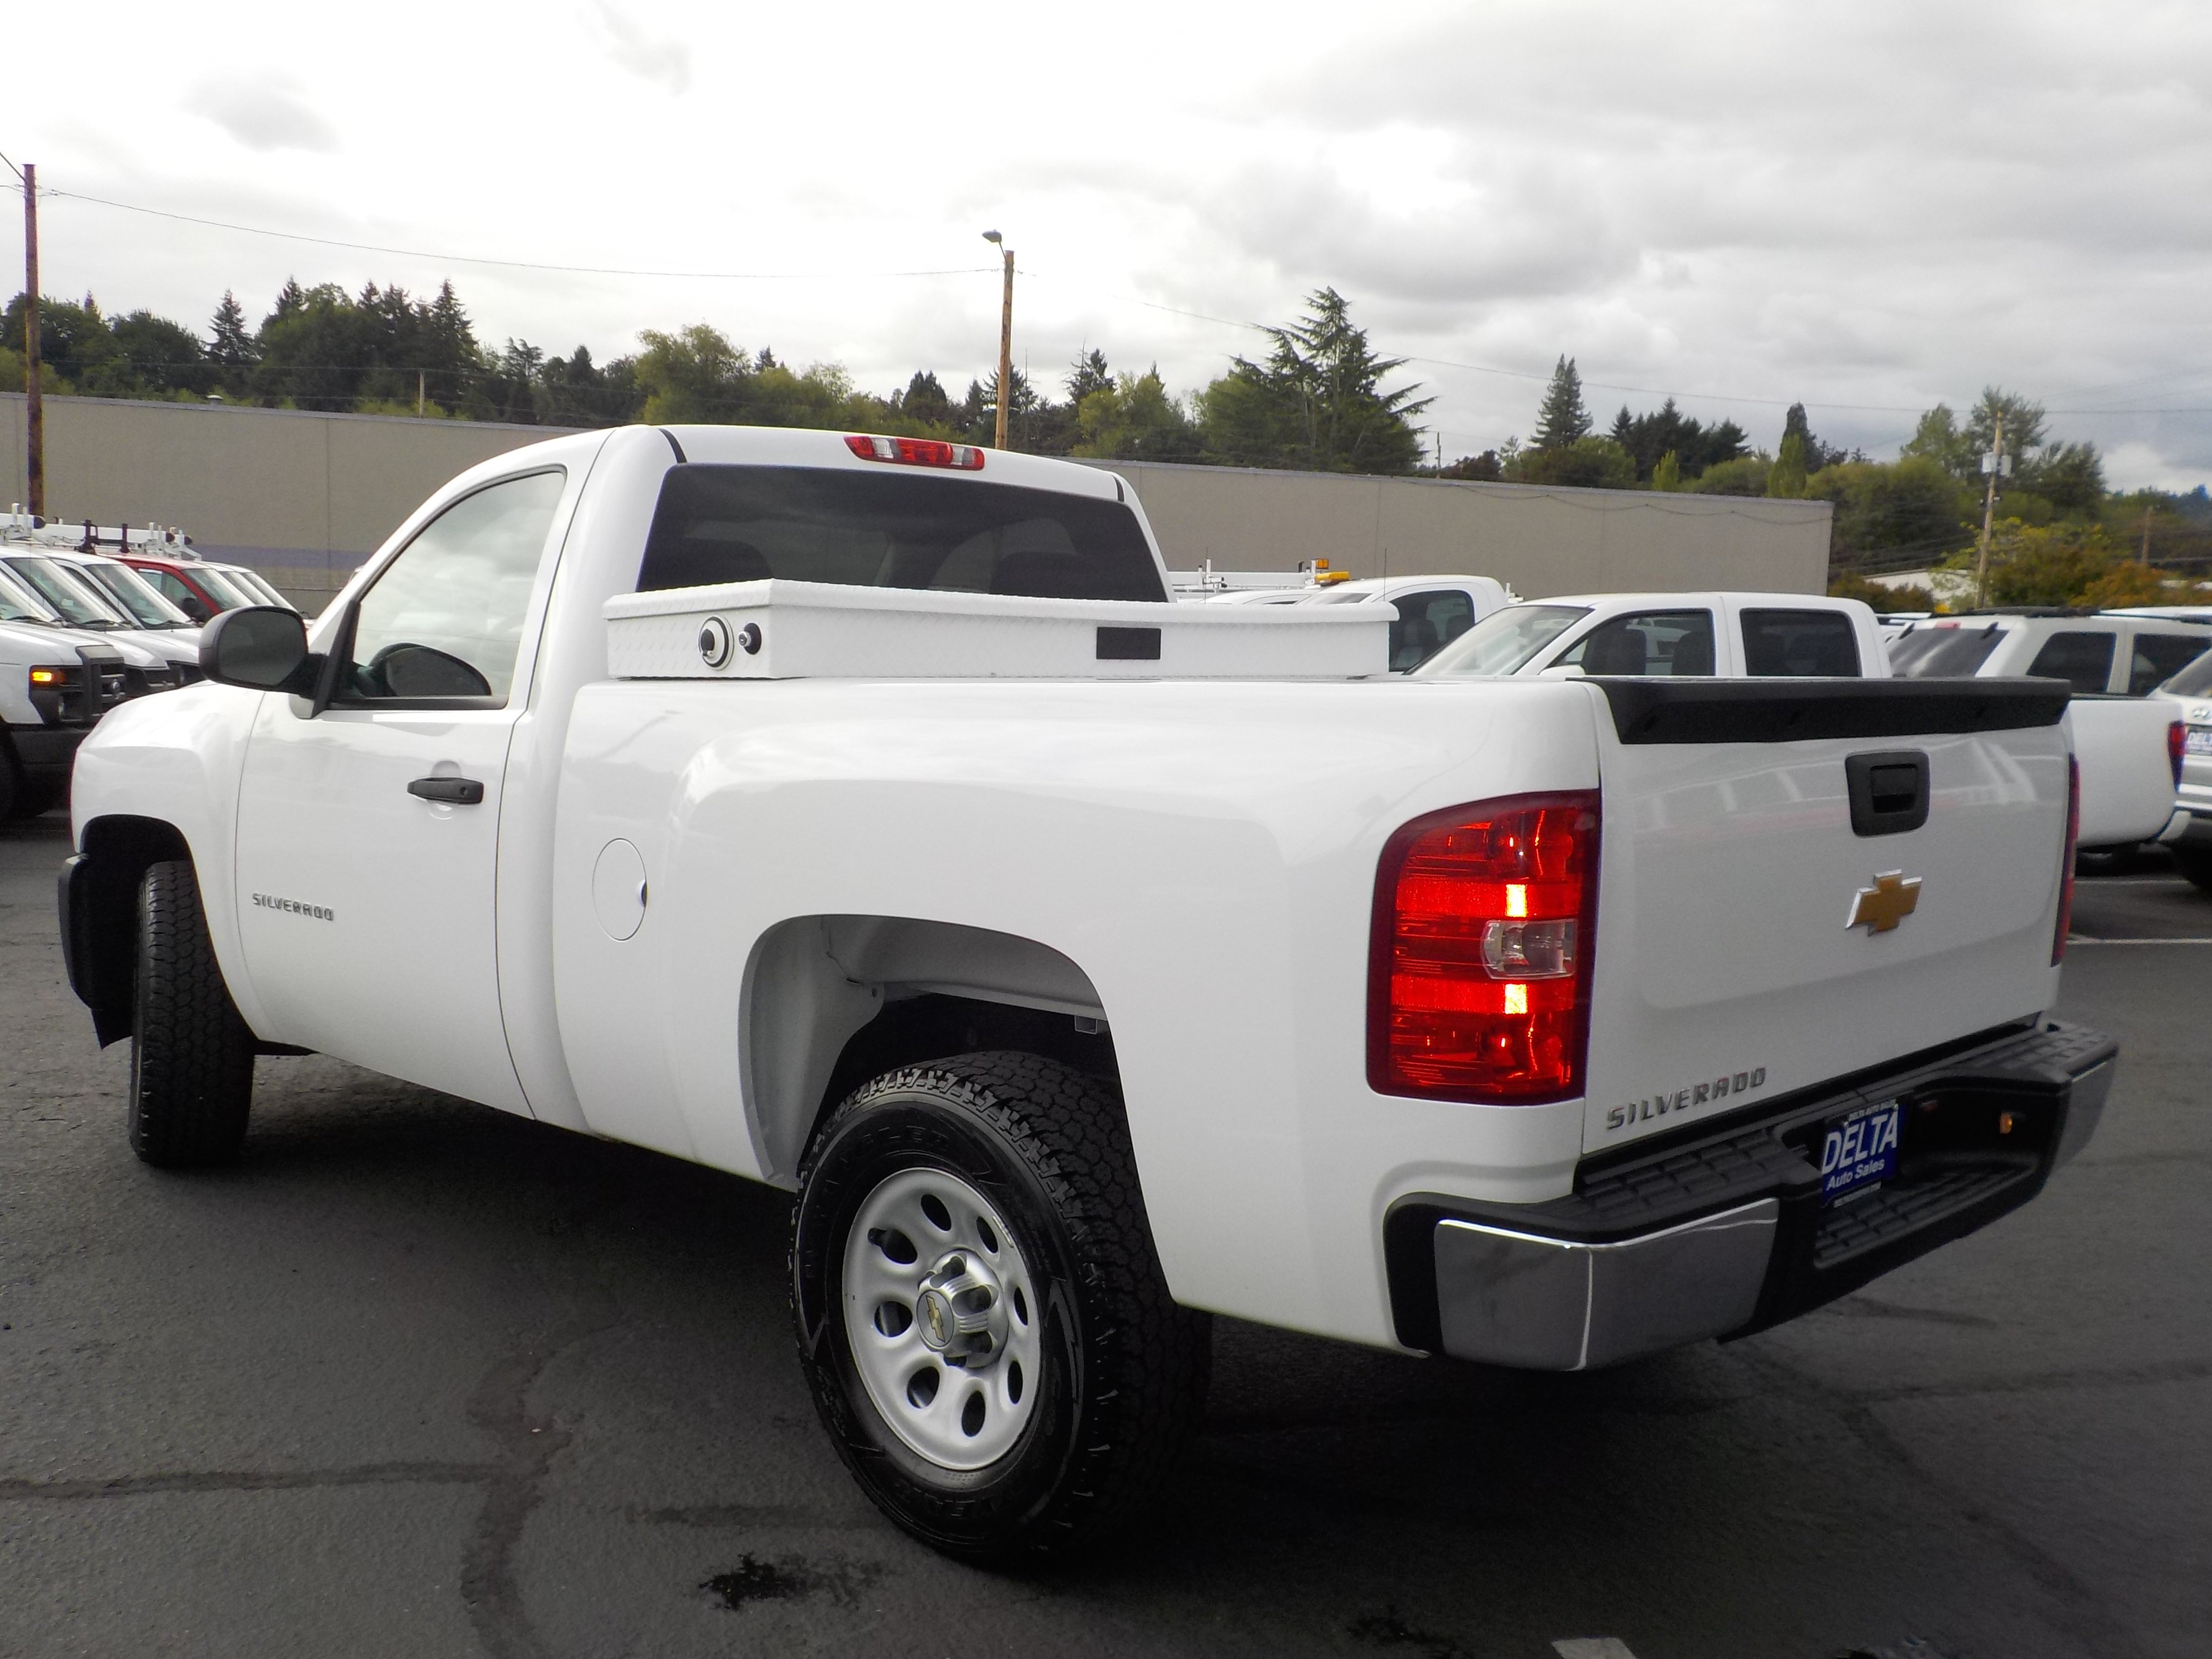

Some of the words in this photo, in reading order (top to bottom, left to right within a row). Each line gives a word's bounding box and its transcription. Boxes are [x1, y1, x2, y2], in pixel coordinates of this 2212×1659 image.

[252, 892, 334, 921] SILVERADO
[1606, 1066, 1766, 1130] SILVERADO
[1821, 1108, 1899, 1175] DELTA
[1826, 1171, 1854, 1191] Auto
[1855, 1159, 1885, 1179] Sales
